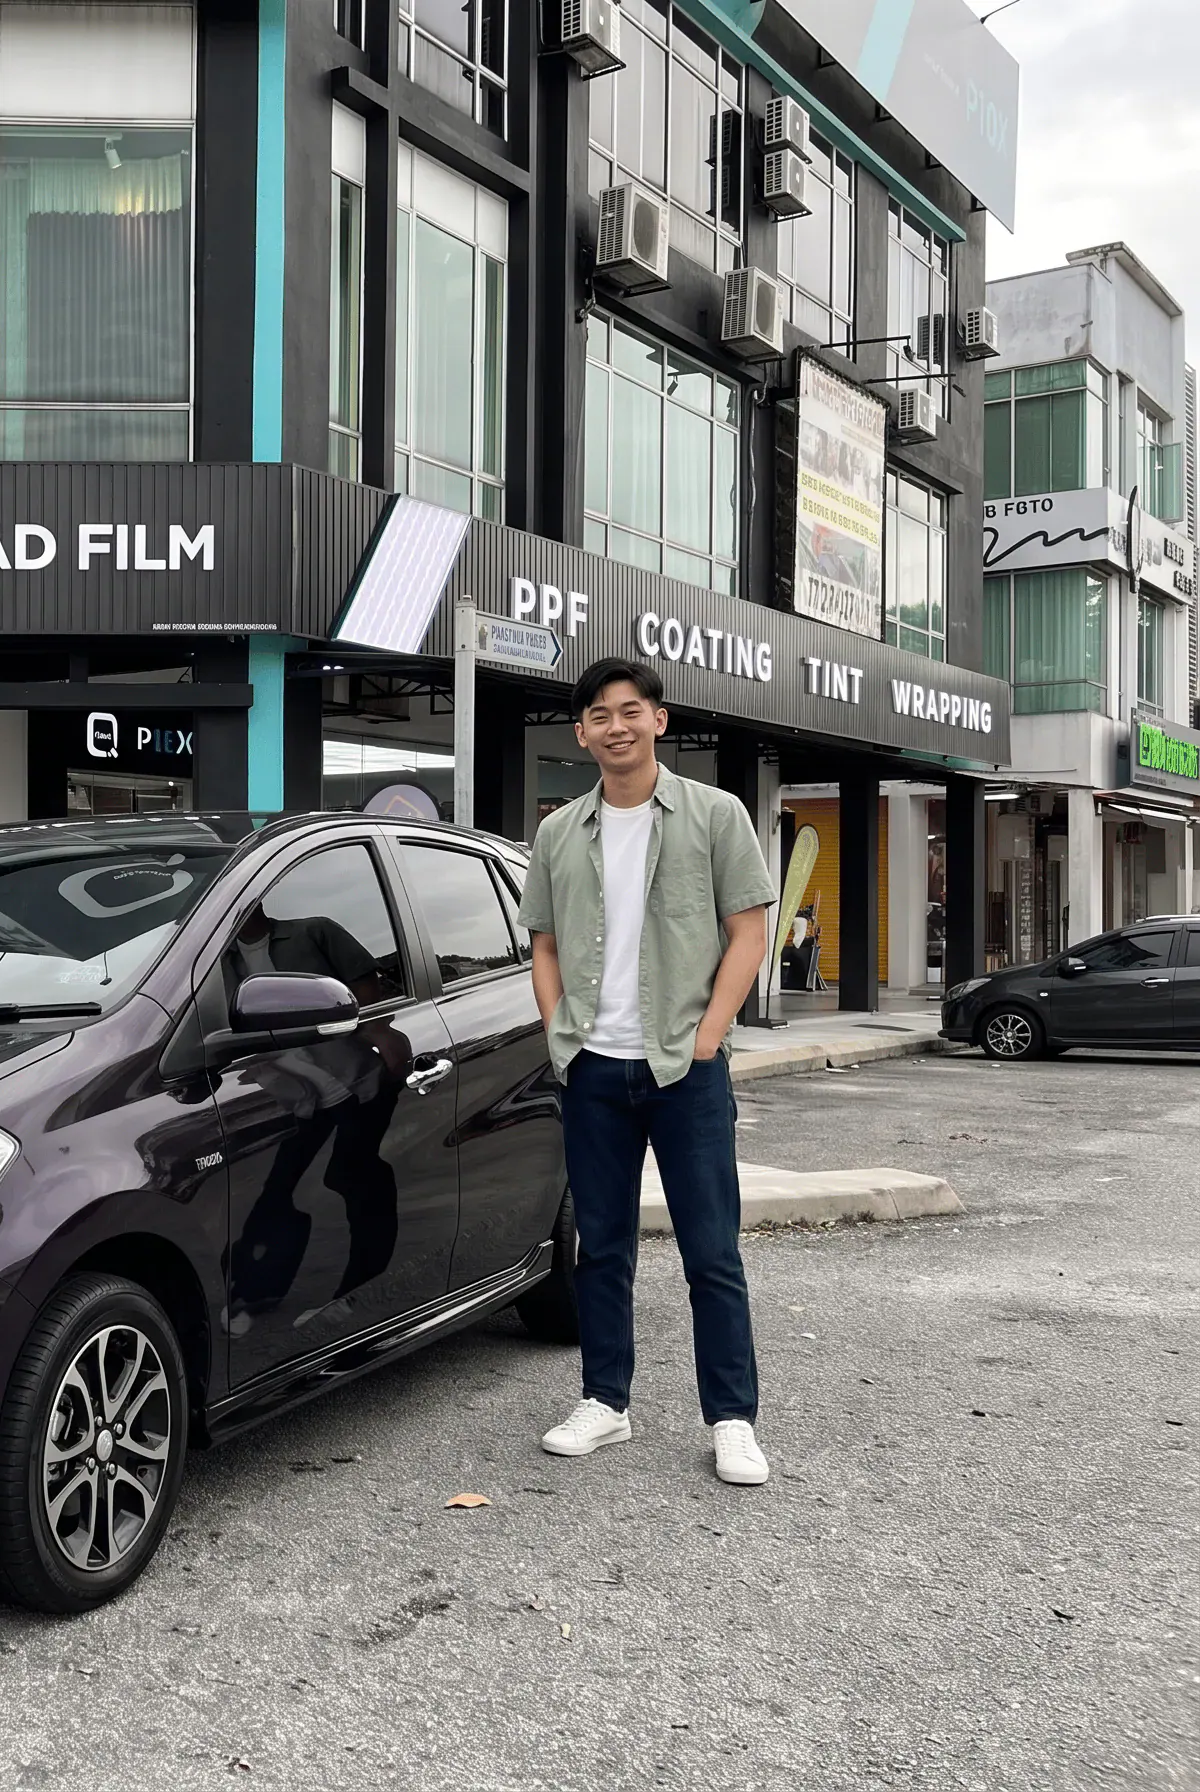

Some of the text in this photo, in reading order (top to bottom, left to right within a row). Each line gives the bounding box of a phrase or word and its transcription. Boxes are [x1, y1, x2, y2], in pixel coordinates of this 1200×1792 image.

[78, 523, 215, 571] FILM
[508, 576, 993, 734] PPF COATING TINT WRAPPING
